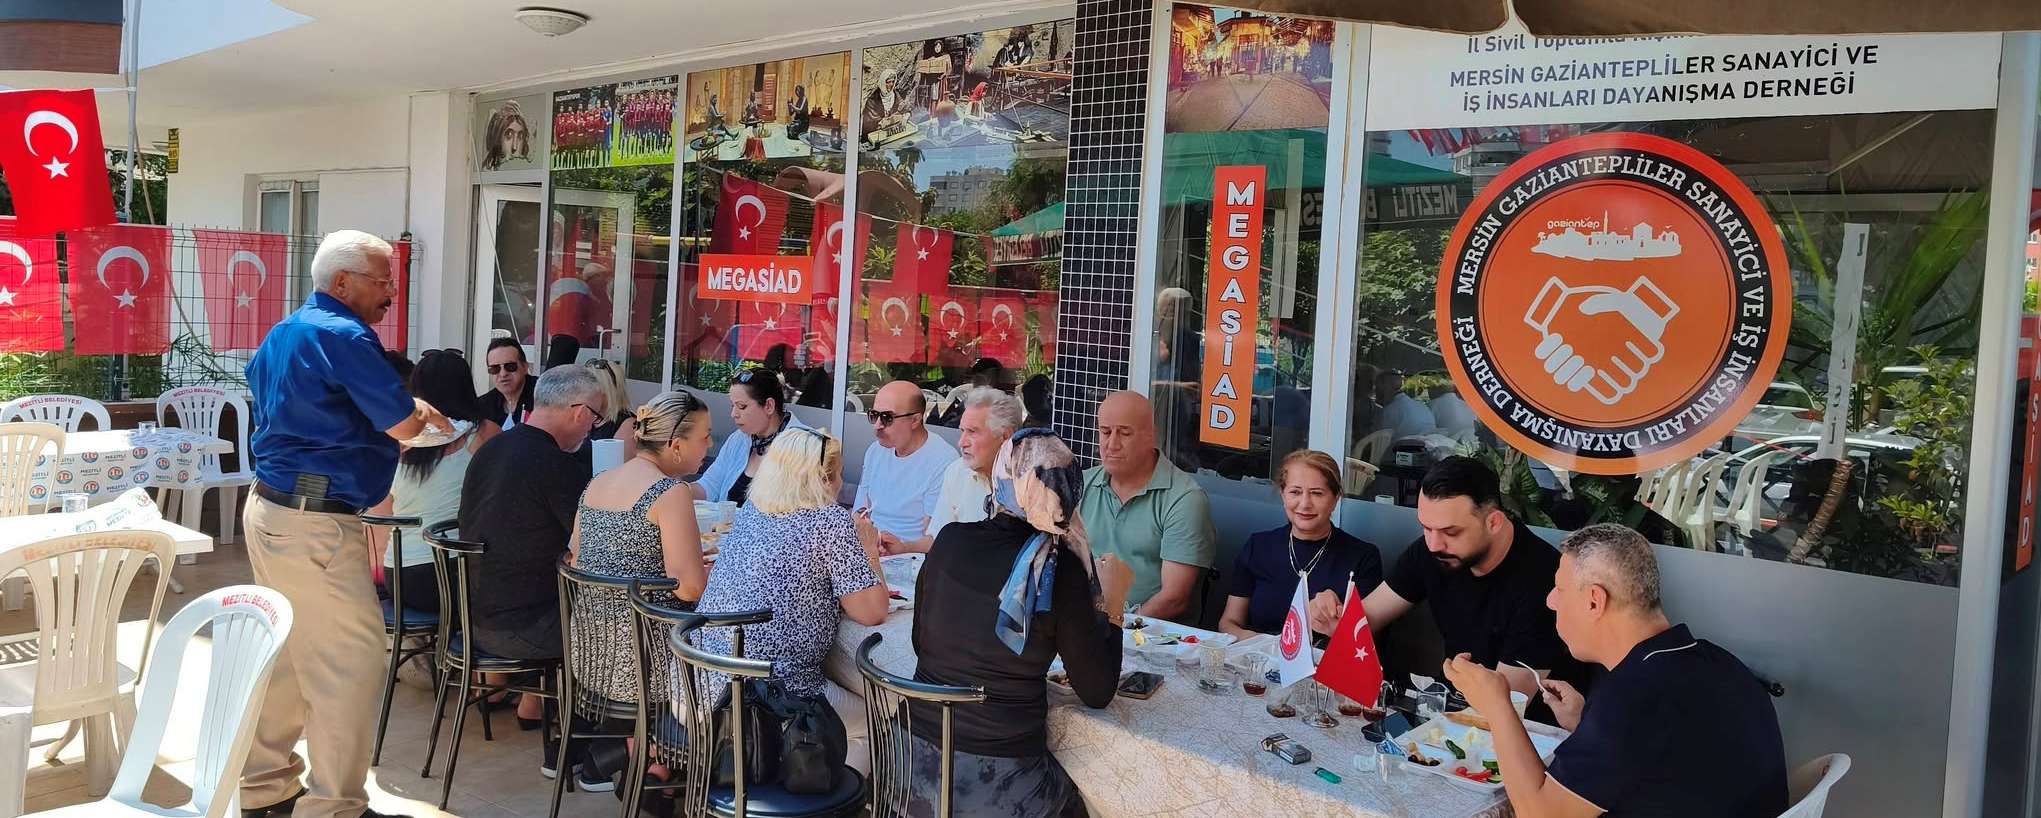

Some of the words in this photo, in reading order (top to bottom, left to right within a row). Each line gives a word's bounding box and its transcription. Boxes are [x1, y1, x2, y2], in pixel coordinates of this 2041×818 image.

[1450, 62, 1525, 88] MERSİN
[1530, 54, 1715, 83] GAZİANTEPLİLER
[1722, 43, 1838, 71] SANAYİCİ
[1846, 45, 1879, 66] VE
[1485, 34, 1526, 52] Sivil
[1463, 91, 1480, 112] İŞ
[1486, 87, 1596, 110] İNSANLARI
[1603, 82, 1737, 105] DAYANIŞMA
[1743, 71, 1856, 99] DERNEĞİ
[1499, 153, 1687, 217] GAZİANTEPLİLER
[1547, 217, 1600, 230] gaziantep
[1686, 181, 1763, 281] SANAYİCİ
[707, 262, 802, 294] MEGASİAD
[1457, 215, 1502, 295] MERSİN
[1209, 181, 1256, 430] MEGASİAD
[1743, 286, 1765, 318] VE
[1733, 324, 1761, 350] İŞ
[1453, 315, 1514, 411] DERNEĞİ
[1649, 351, 1757, 445] İNSANLARI
[1510, 403, 1640, 451] DAYANIŞMA
[2021, 318, 2041, 547] ASİAD
